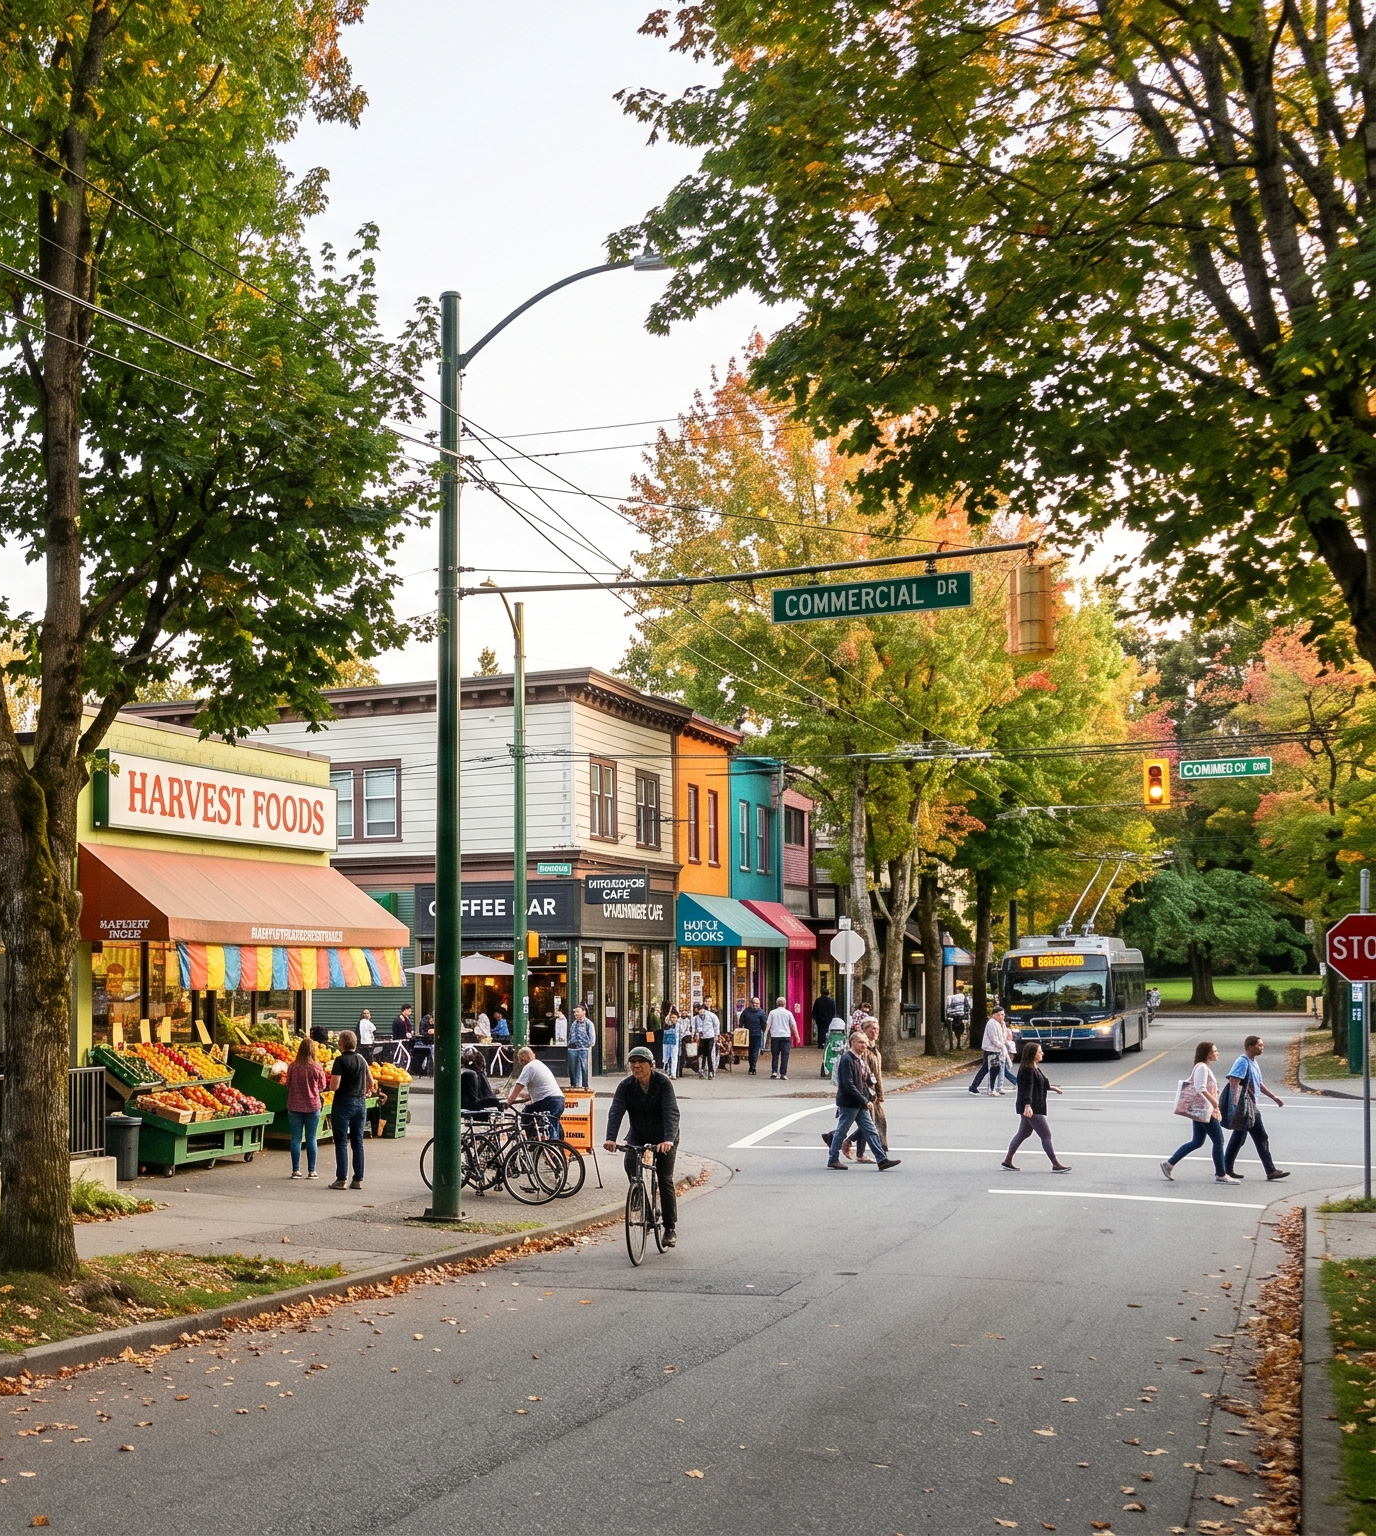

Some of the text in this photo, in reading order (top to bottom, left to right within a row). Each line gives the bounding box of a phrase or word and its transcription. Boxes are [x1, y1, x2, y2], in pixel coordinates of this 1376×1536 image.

[785, 579, 958, 617] COMMERCIAL DR
[128, 770, 325, 836] HARVEST FOODS
[602, 889, 631, 900] CAFE
[428, 899, 506, 917] CFFEE
[684, 931, 724, 942] BOOKS
[1332, 935, 1376, 960] STO
